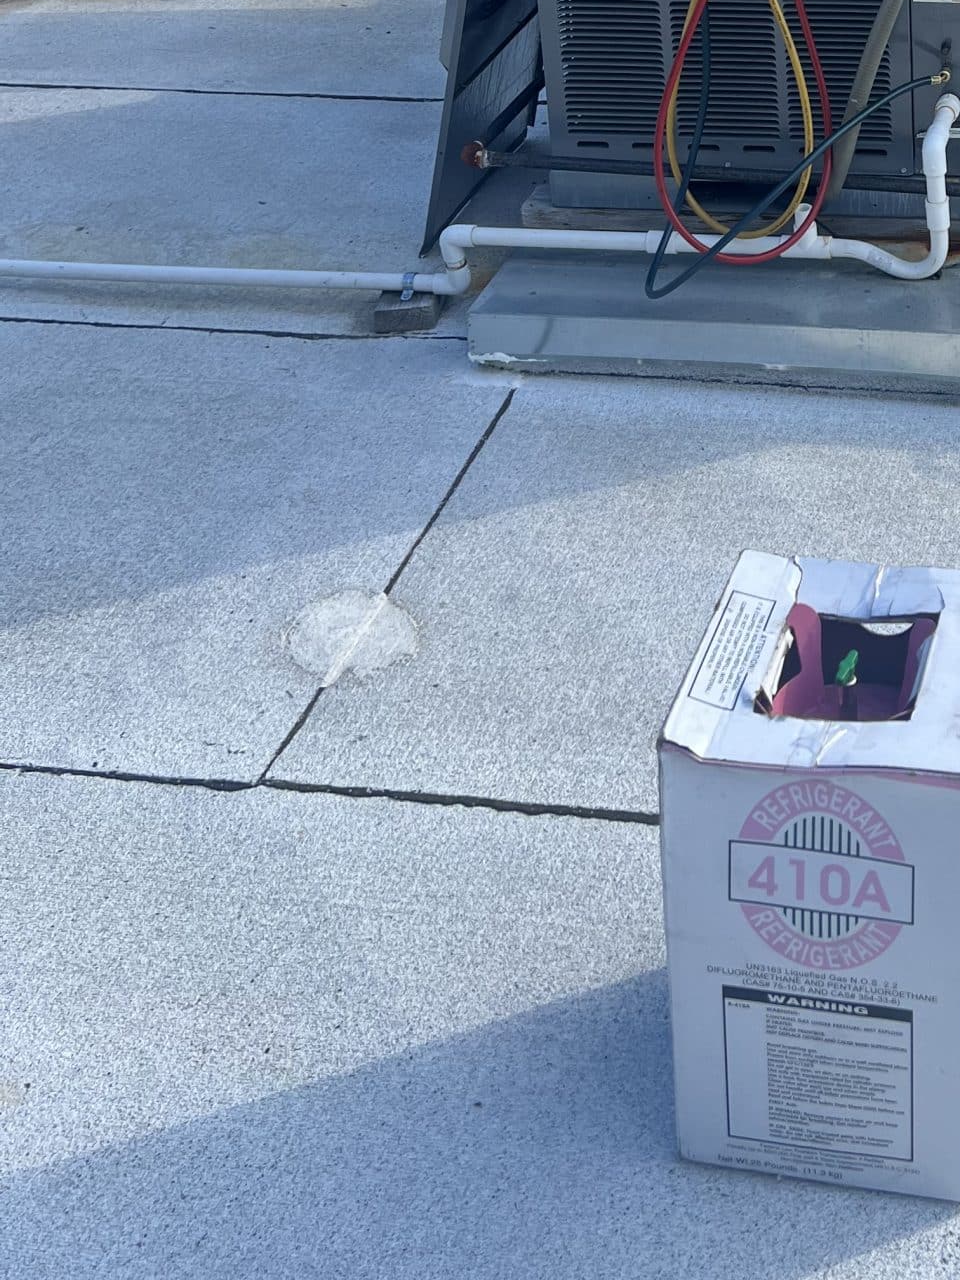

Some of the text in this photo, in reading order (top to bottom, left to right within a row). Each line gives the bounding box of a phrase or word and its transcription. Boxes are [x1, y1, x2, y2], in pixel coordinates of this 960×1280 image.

[751, 782, 896, 850] REFRIGERANT
[747, 855, 892, 913] 410A
[749, 911, 893, 969] REFRIGERANT
[784, 969, 827, 981] Liquefied
[829, 974, 848, 982] Gas
[804, 978, 825, 987] AND
[807, 986, 828, 996] AND
[766, 992, 869, 1016] WARNING
